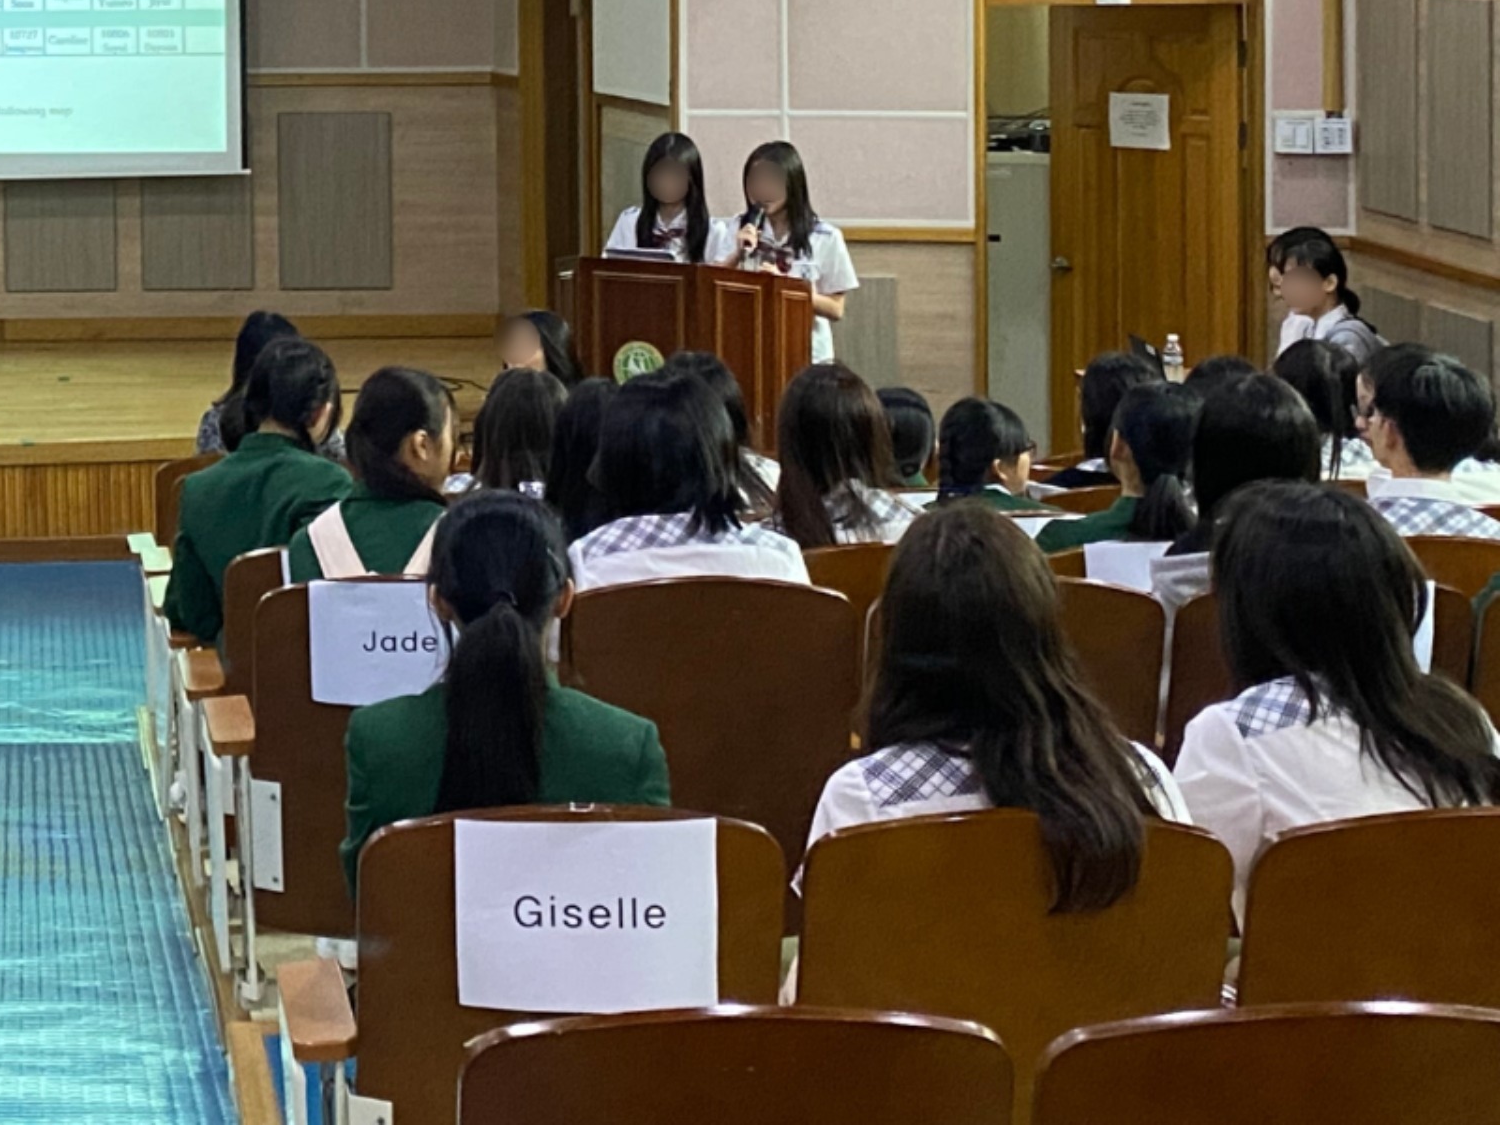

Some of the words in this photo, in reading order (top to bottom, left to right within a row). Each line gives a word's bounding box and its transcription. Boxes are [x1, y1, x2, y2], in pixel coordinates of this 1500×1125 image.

[48, 106, 73, 118] map
[362, 630, 438, 653] Jade
[513, 895, 667, 930] Giselle
